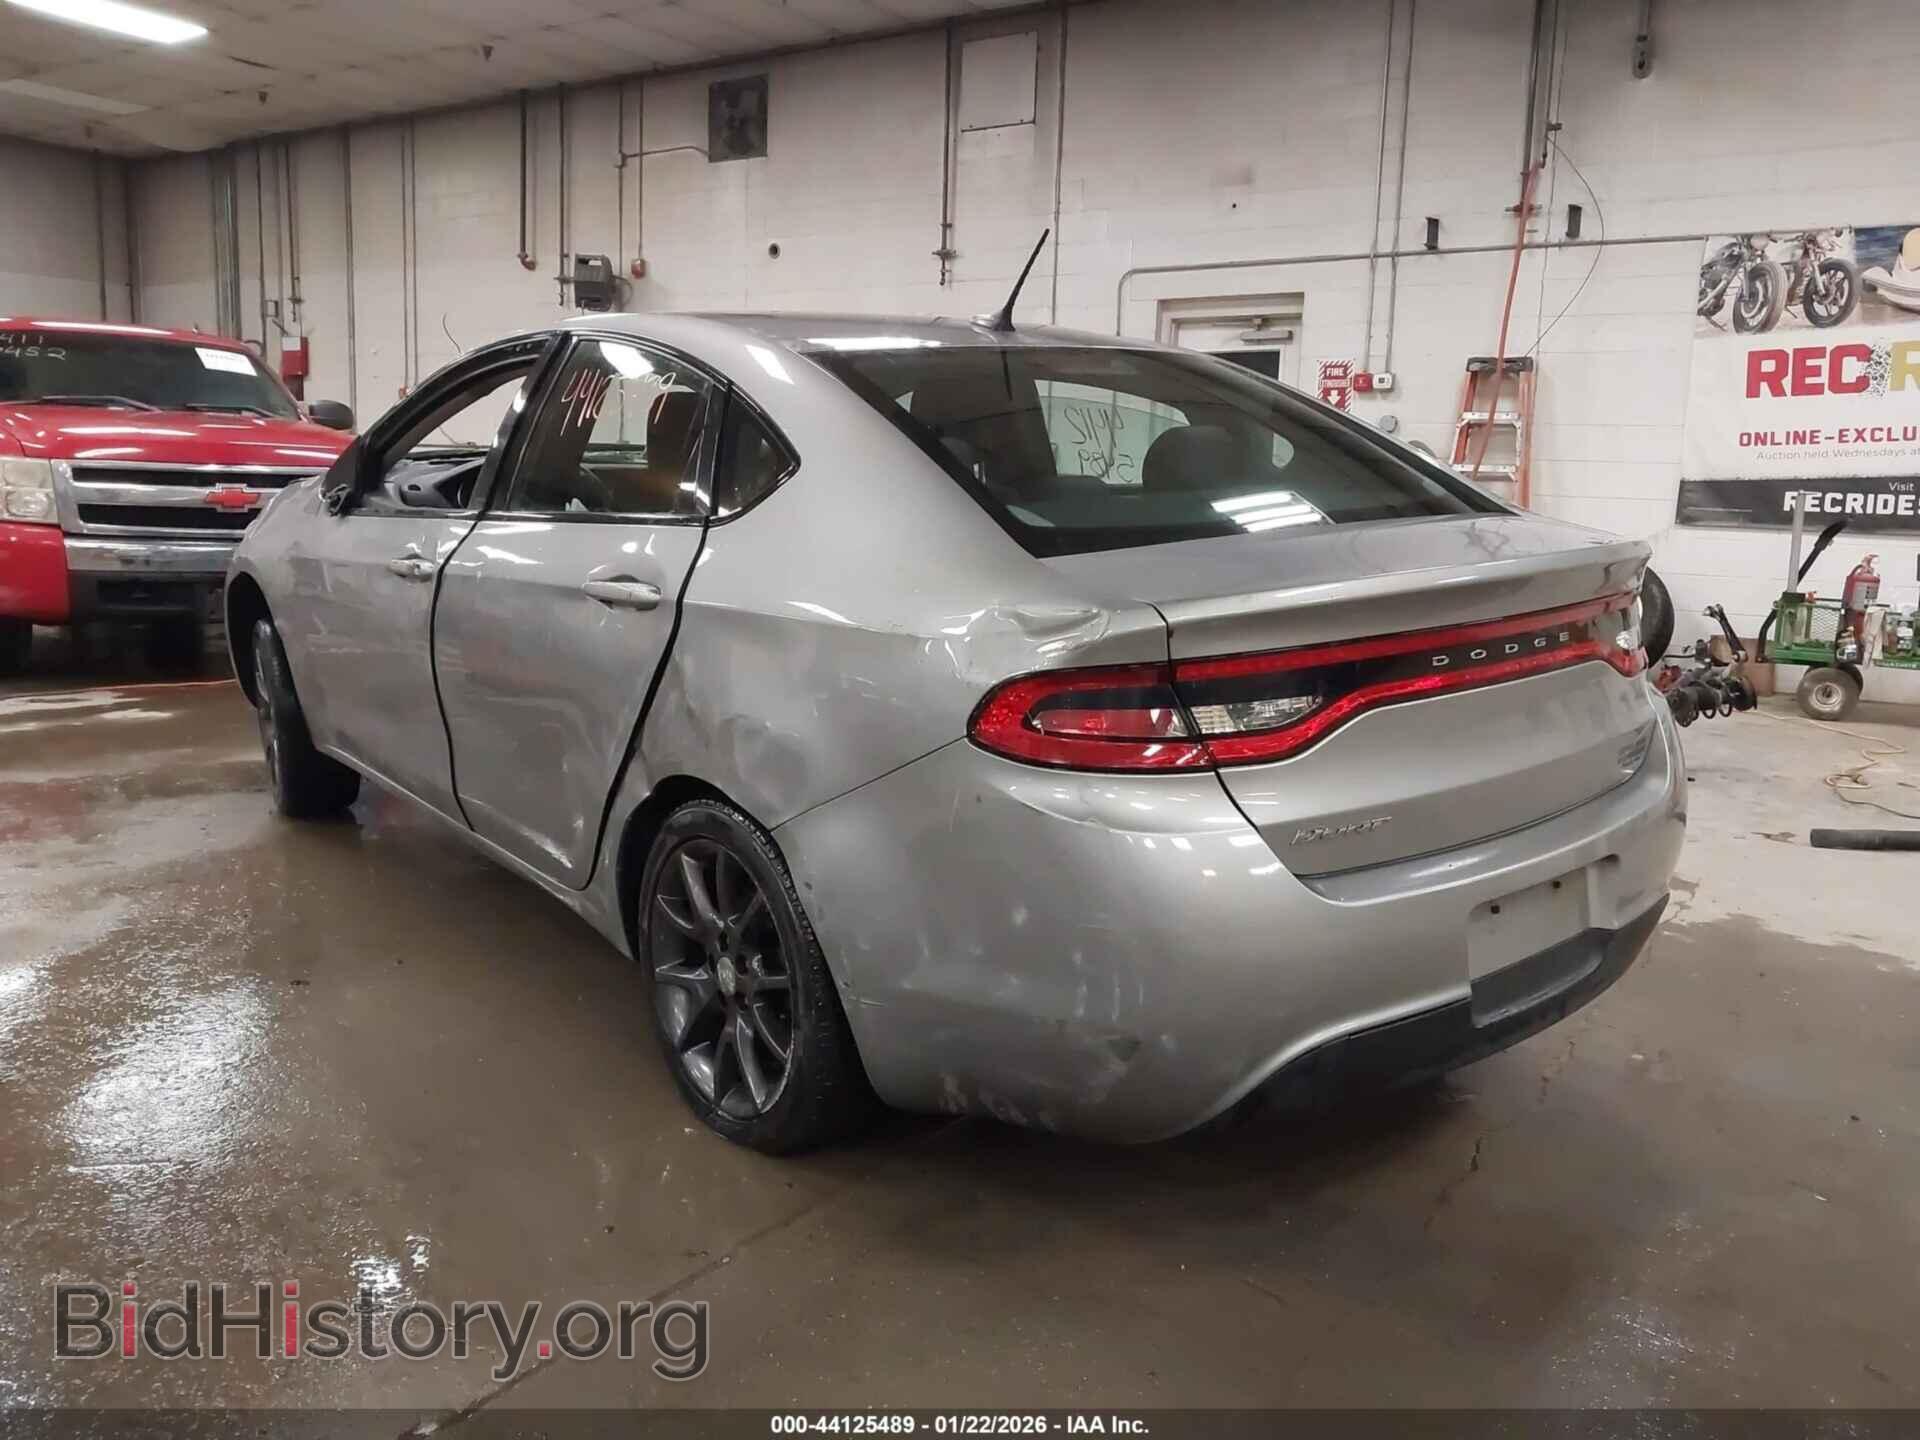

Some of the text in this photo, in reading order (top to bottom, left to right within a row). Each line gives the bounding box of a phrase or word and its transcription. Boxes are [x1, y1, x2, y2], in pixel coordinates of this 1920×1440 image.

[1326, 367, 1345, 377] FIRE
[1739, 426, 1918, 447] ONLINE-EXCLU
[1756, 450, 1801, 460] Auction
[1804, 447, 1829, 458] held
[1832, 446, 1906, 459] Wednesdays
[1888, 481, 1915, 491] Visit
[1432, 632, 1569, 667] DODGE
